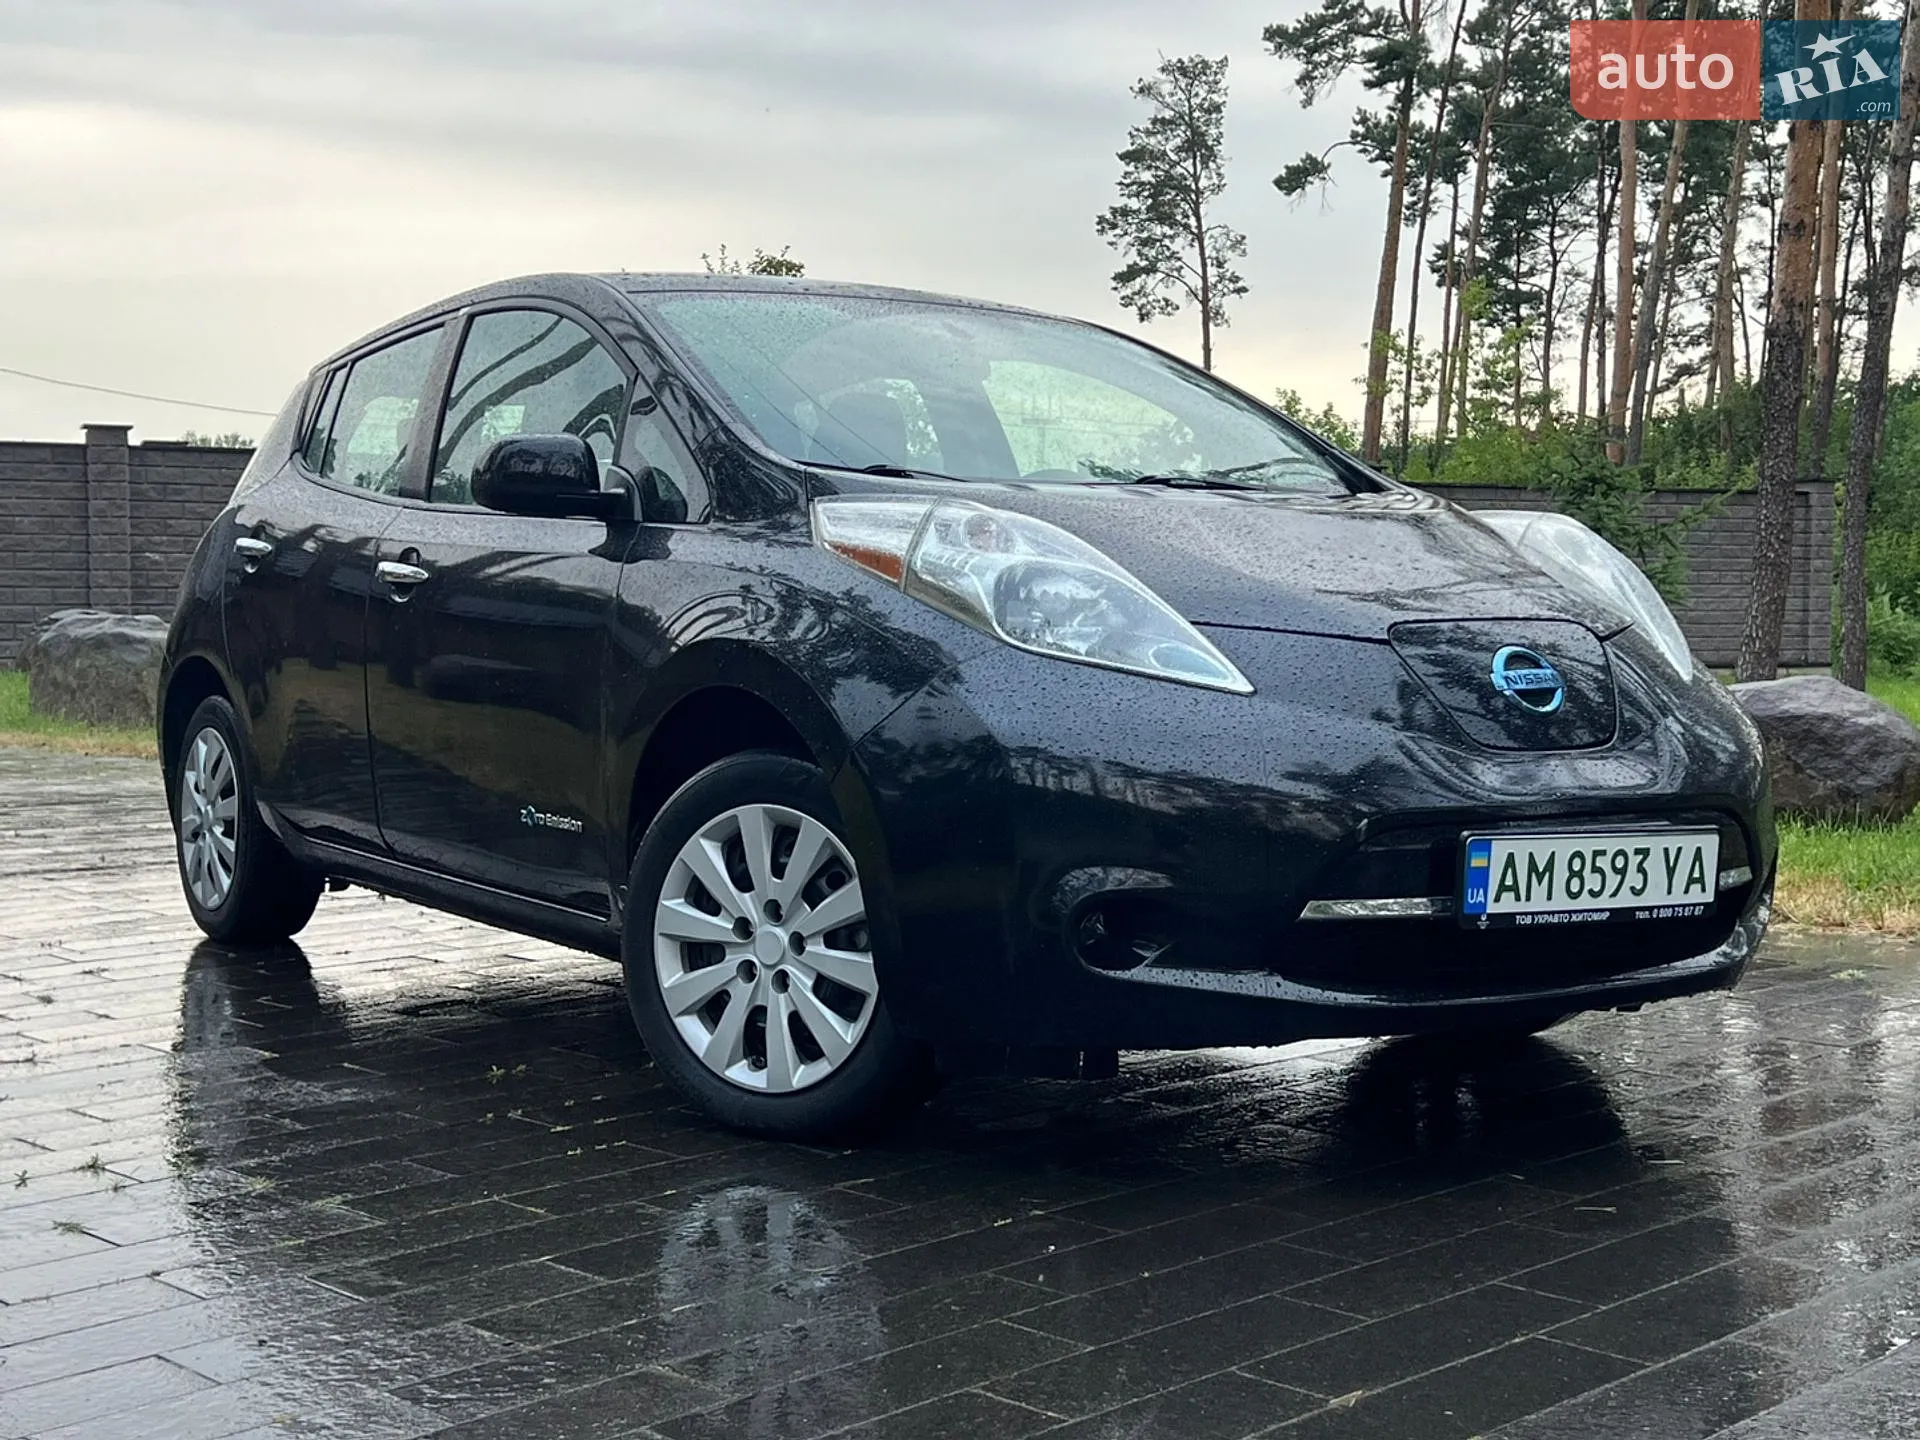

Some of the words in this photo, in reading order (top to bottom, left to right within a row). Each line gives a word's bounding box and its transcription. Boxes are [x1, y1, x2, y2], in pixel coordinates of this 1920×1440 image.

[1493, 850, 1556, 903] AM
[1565, 846, 1652, 900] 8593
[1662, 846, 1707, 895] YA
[1468, 888, 1485, 904] UA
